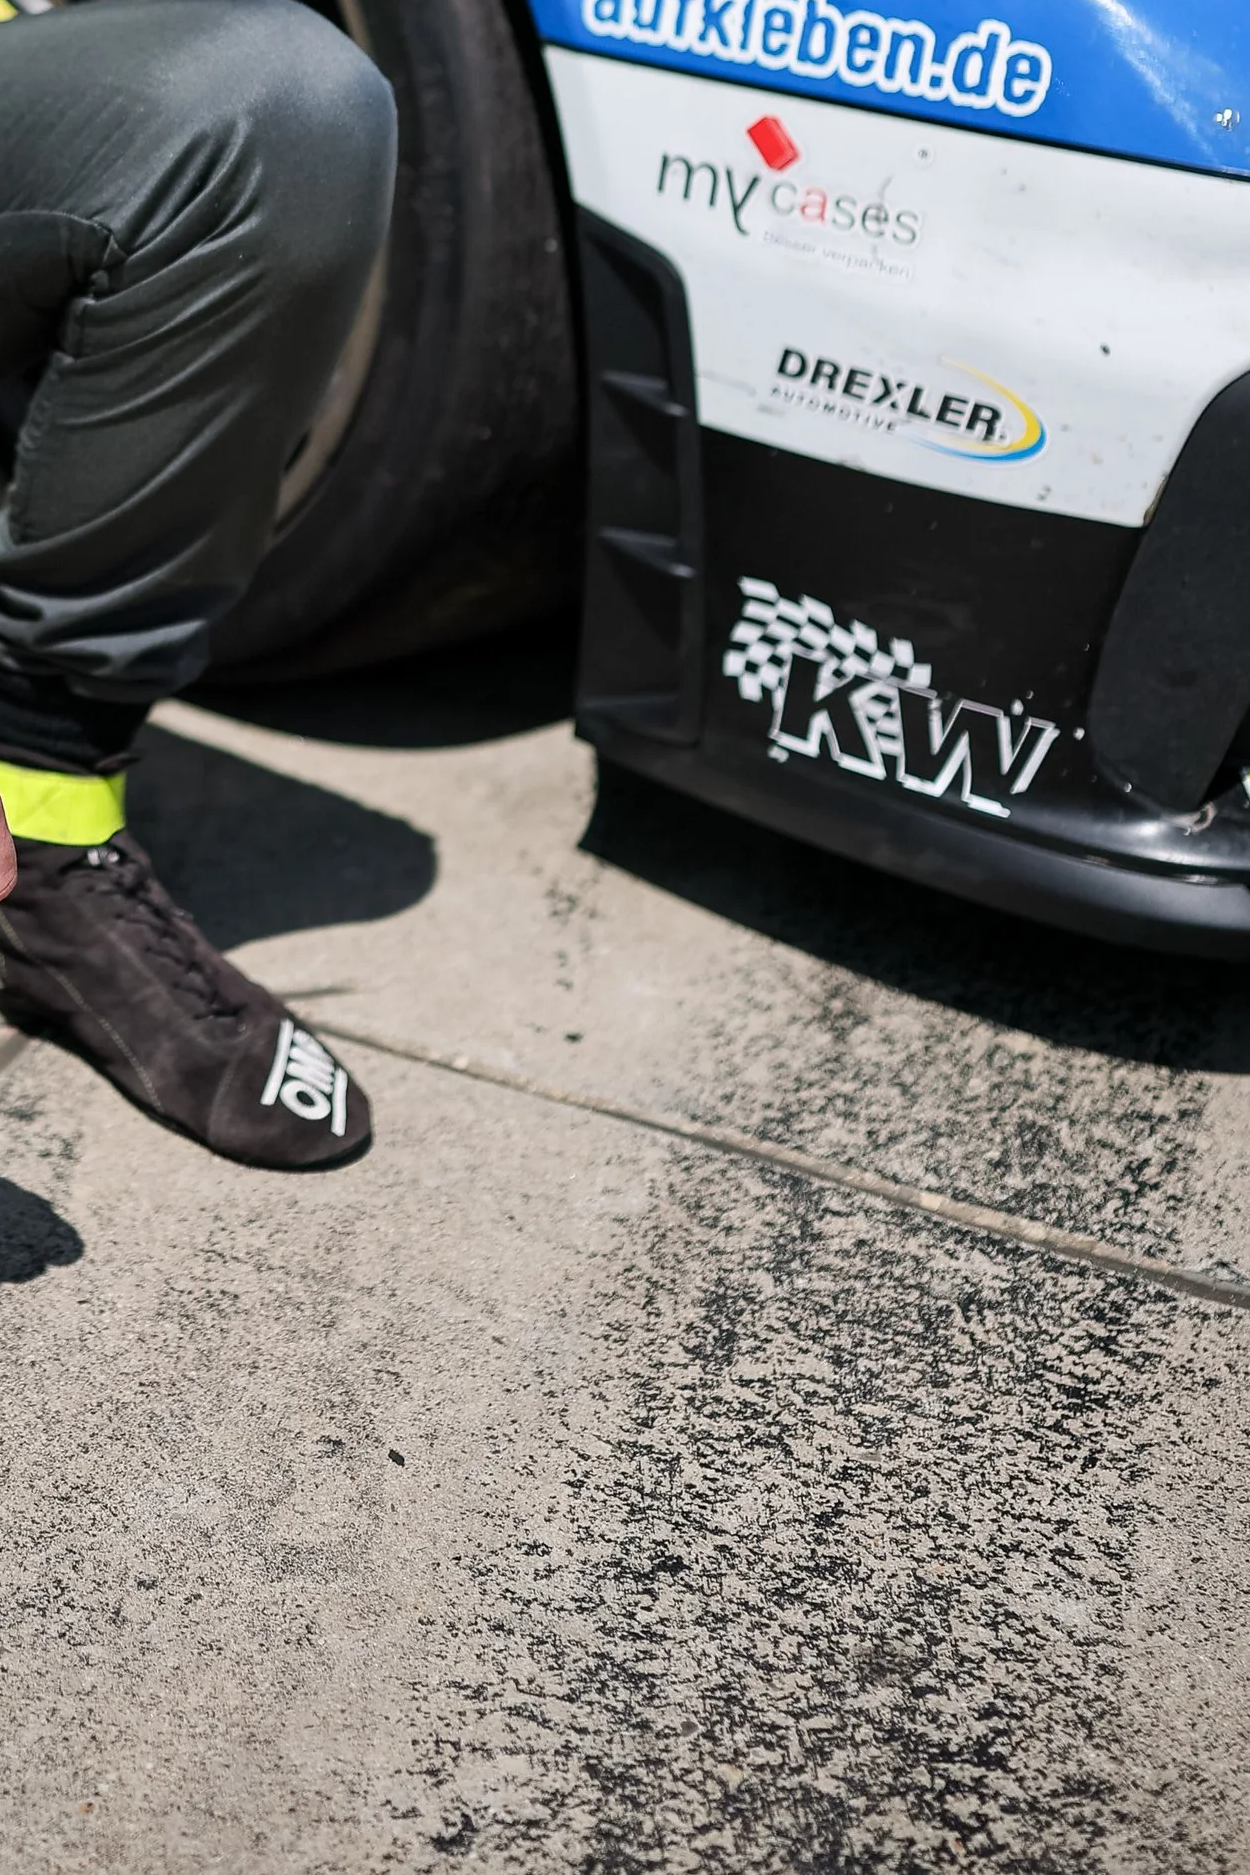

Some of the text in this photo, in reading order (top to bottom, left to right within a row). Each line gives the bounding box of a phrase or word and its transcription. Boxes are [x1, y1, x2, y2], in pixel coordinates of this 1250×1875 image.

[770, 385, 898, 433] AUTOMOTIVE
[776, 347, 1003, 442] DREXLER
[769, 647, 1062, 819] KW
